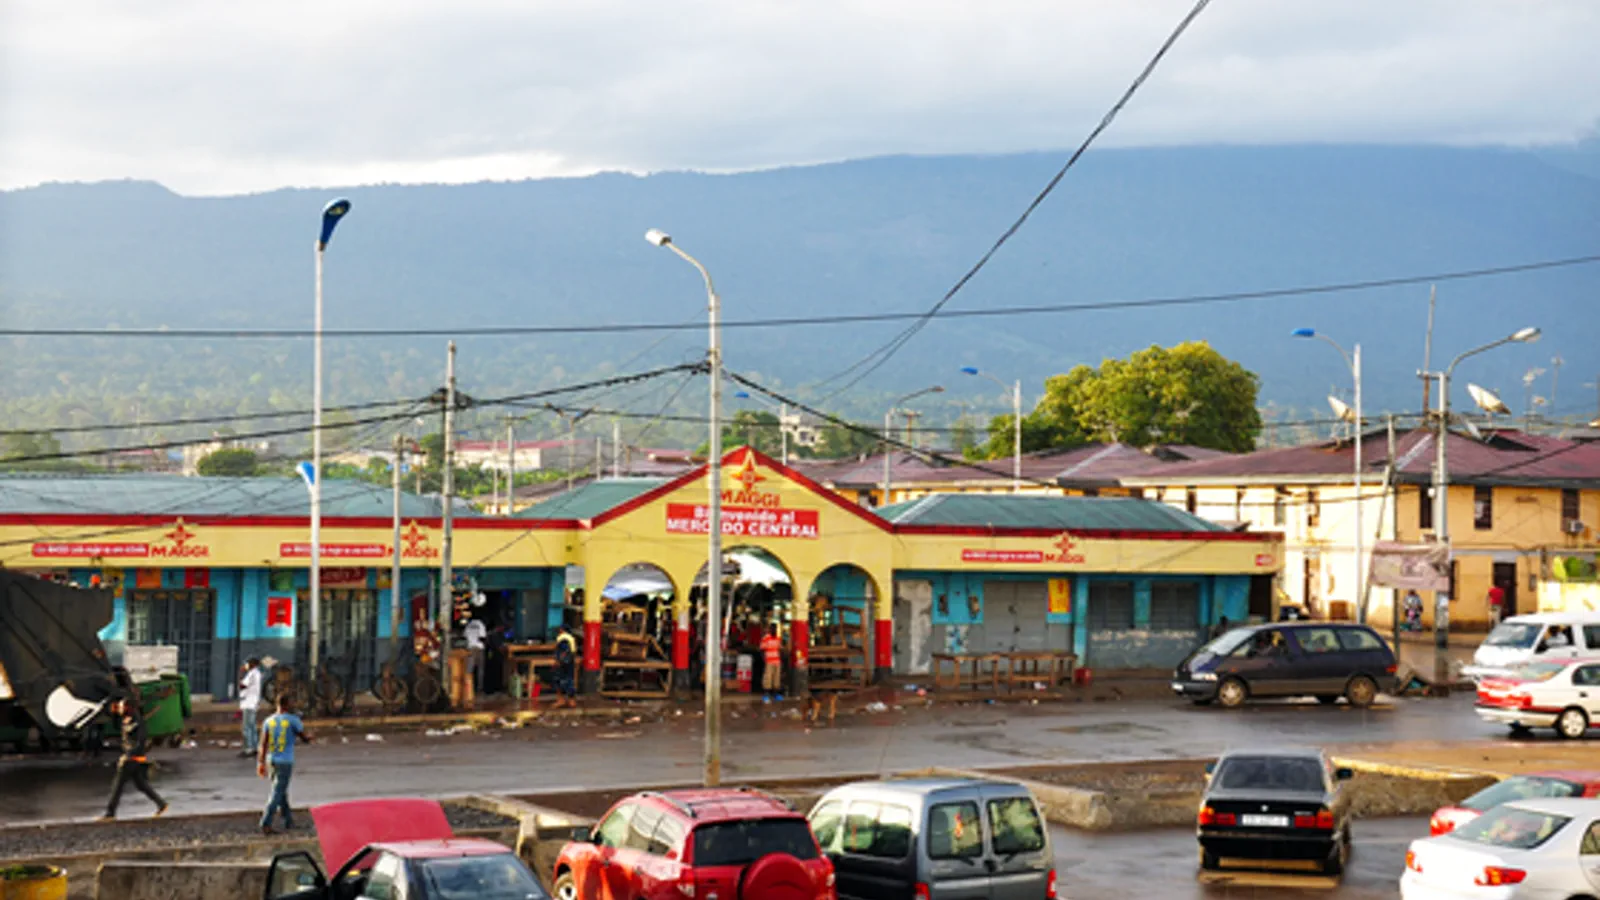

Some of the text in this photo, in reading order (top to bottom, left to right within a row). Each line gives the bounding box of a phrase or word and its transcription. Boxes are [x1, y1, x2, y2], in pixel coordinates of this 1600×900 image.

[720, 489, 780, 507] MAGGI
[694, 506, 795, 521] Binvenido al
[667, 518, 818, 537] MERCDO CENTRAL
[151, 545, 209, 557] MAGGI
